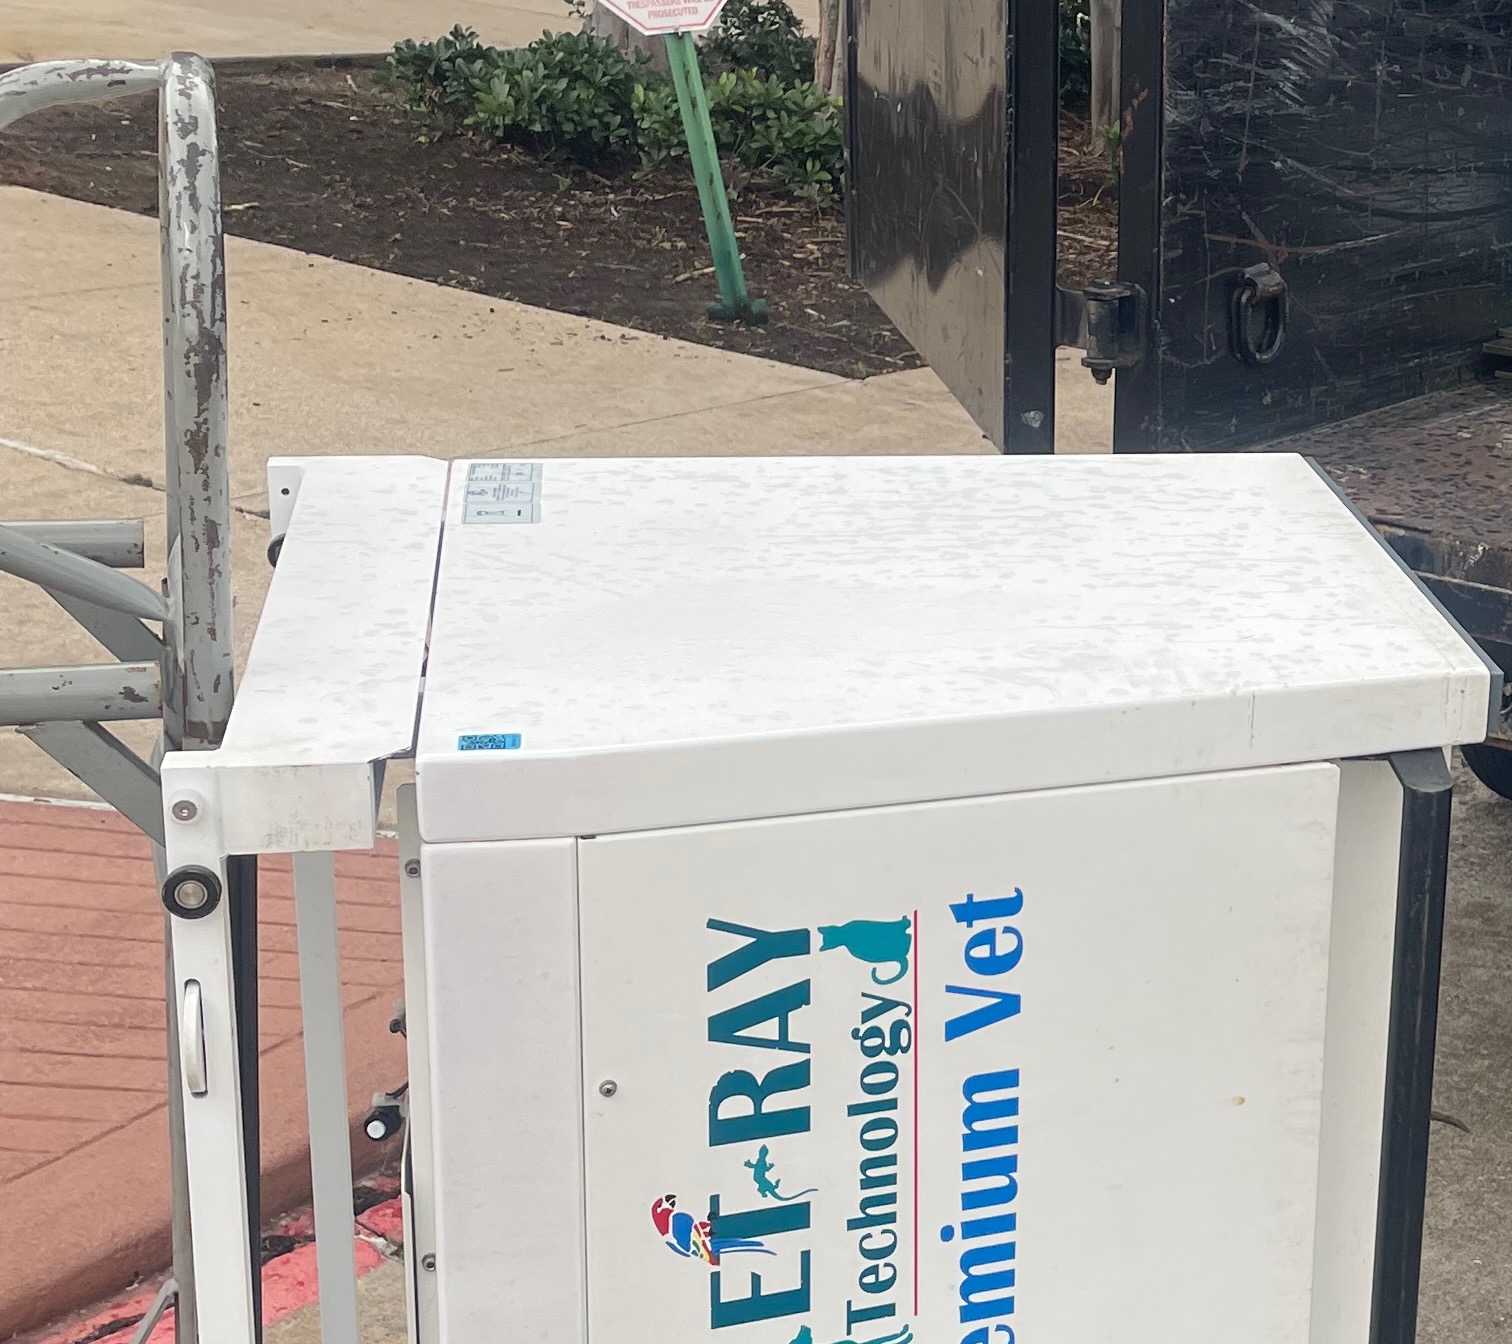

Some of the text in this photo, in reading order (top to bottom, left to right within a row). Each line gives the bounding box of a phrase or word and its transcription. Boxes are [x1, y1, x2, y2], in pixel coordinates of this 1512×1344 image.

[648, 6, 699, 19] PROSECUTED
[944, 887, 1023, 1043] Vet
[846, 992, 912, 1336] Technology
